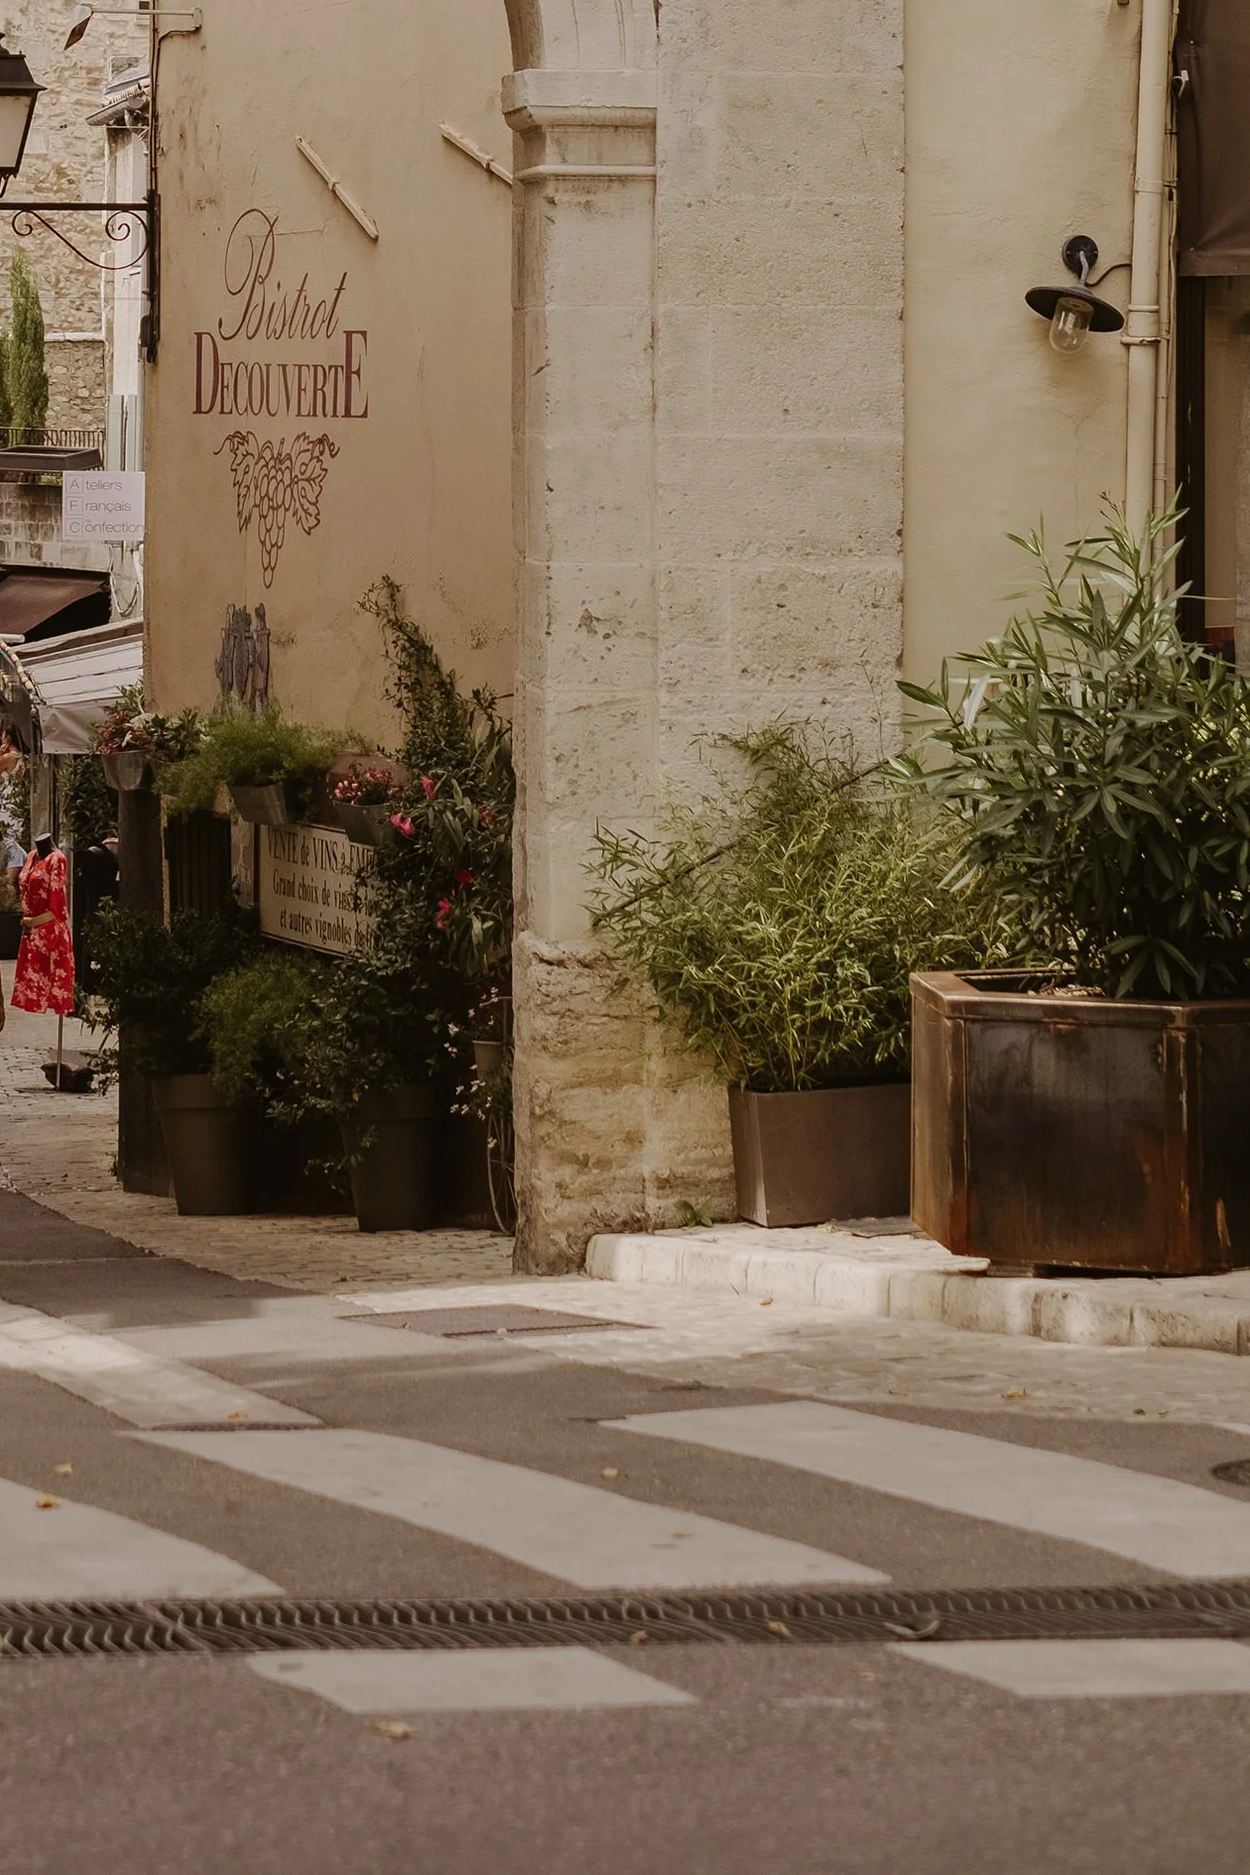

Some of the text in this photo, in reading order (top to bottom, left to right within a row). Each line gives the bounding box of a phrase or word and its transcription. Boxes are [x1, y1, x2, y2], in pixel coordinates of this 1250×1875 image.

[218, 208, 348, 341] Bistrot
[192, 330, 368, 418] DECOUVERTE
[266, 827, 300, 865] VENTE
[300, 836, 311, 867] de
[312, 838, 340, 872] VINS
[272, 868, 297, 900] Grand
[297, 875, 320, 905] choix
[321, 880, 332, 908] de
[279, 908, 289, 929] et
[288, 911, 313, 936] autres
[314, 912, 353, 946] vignobles
